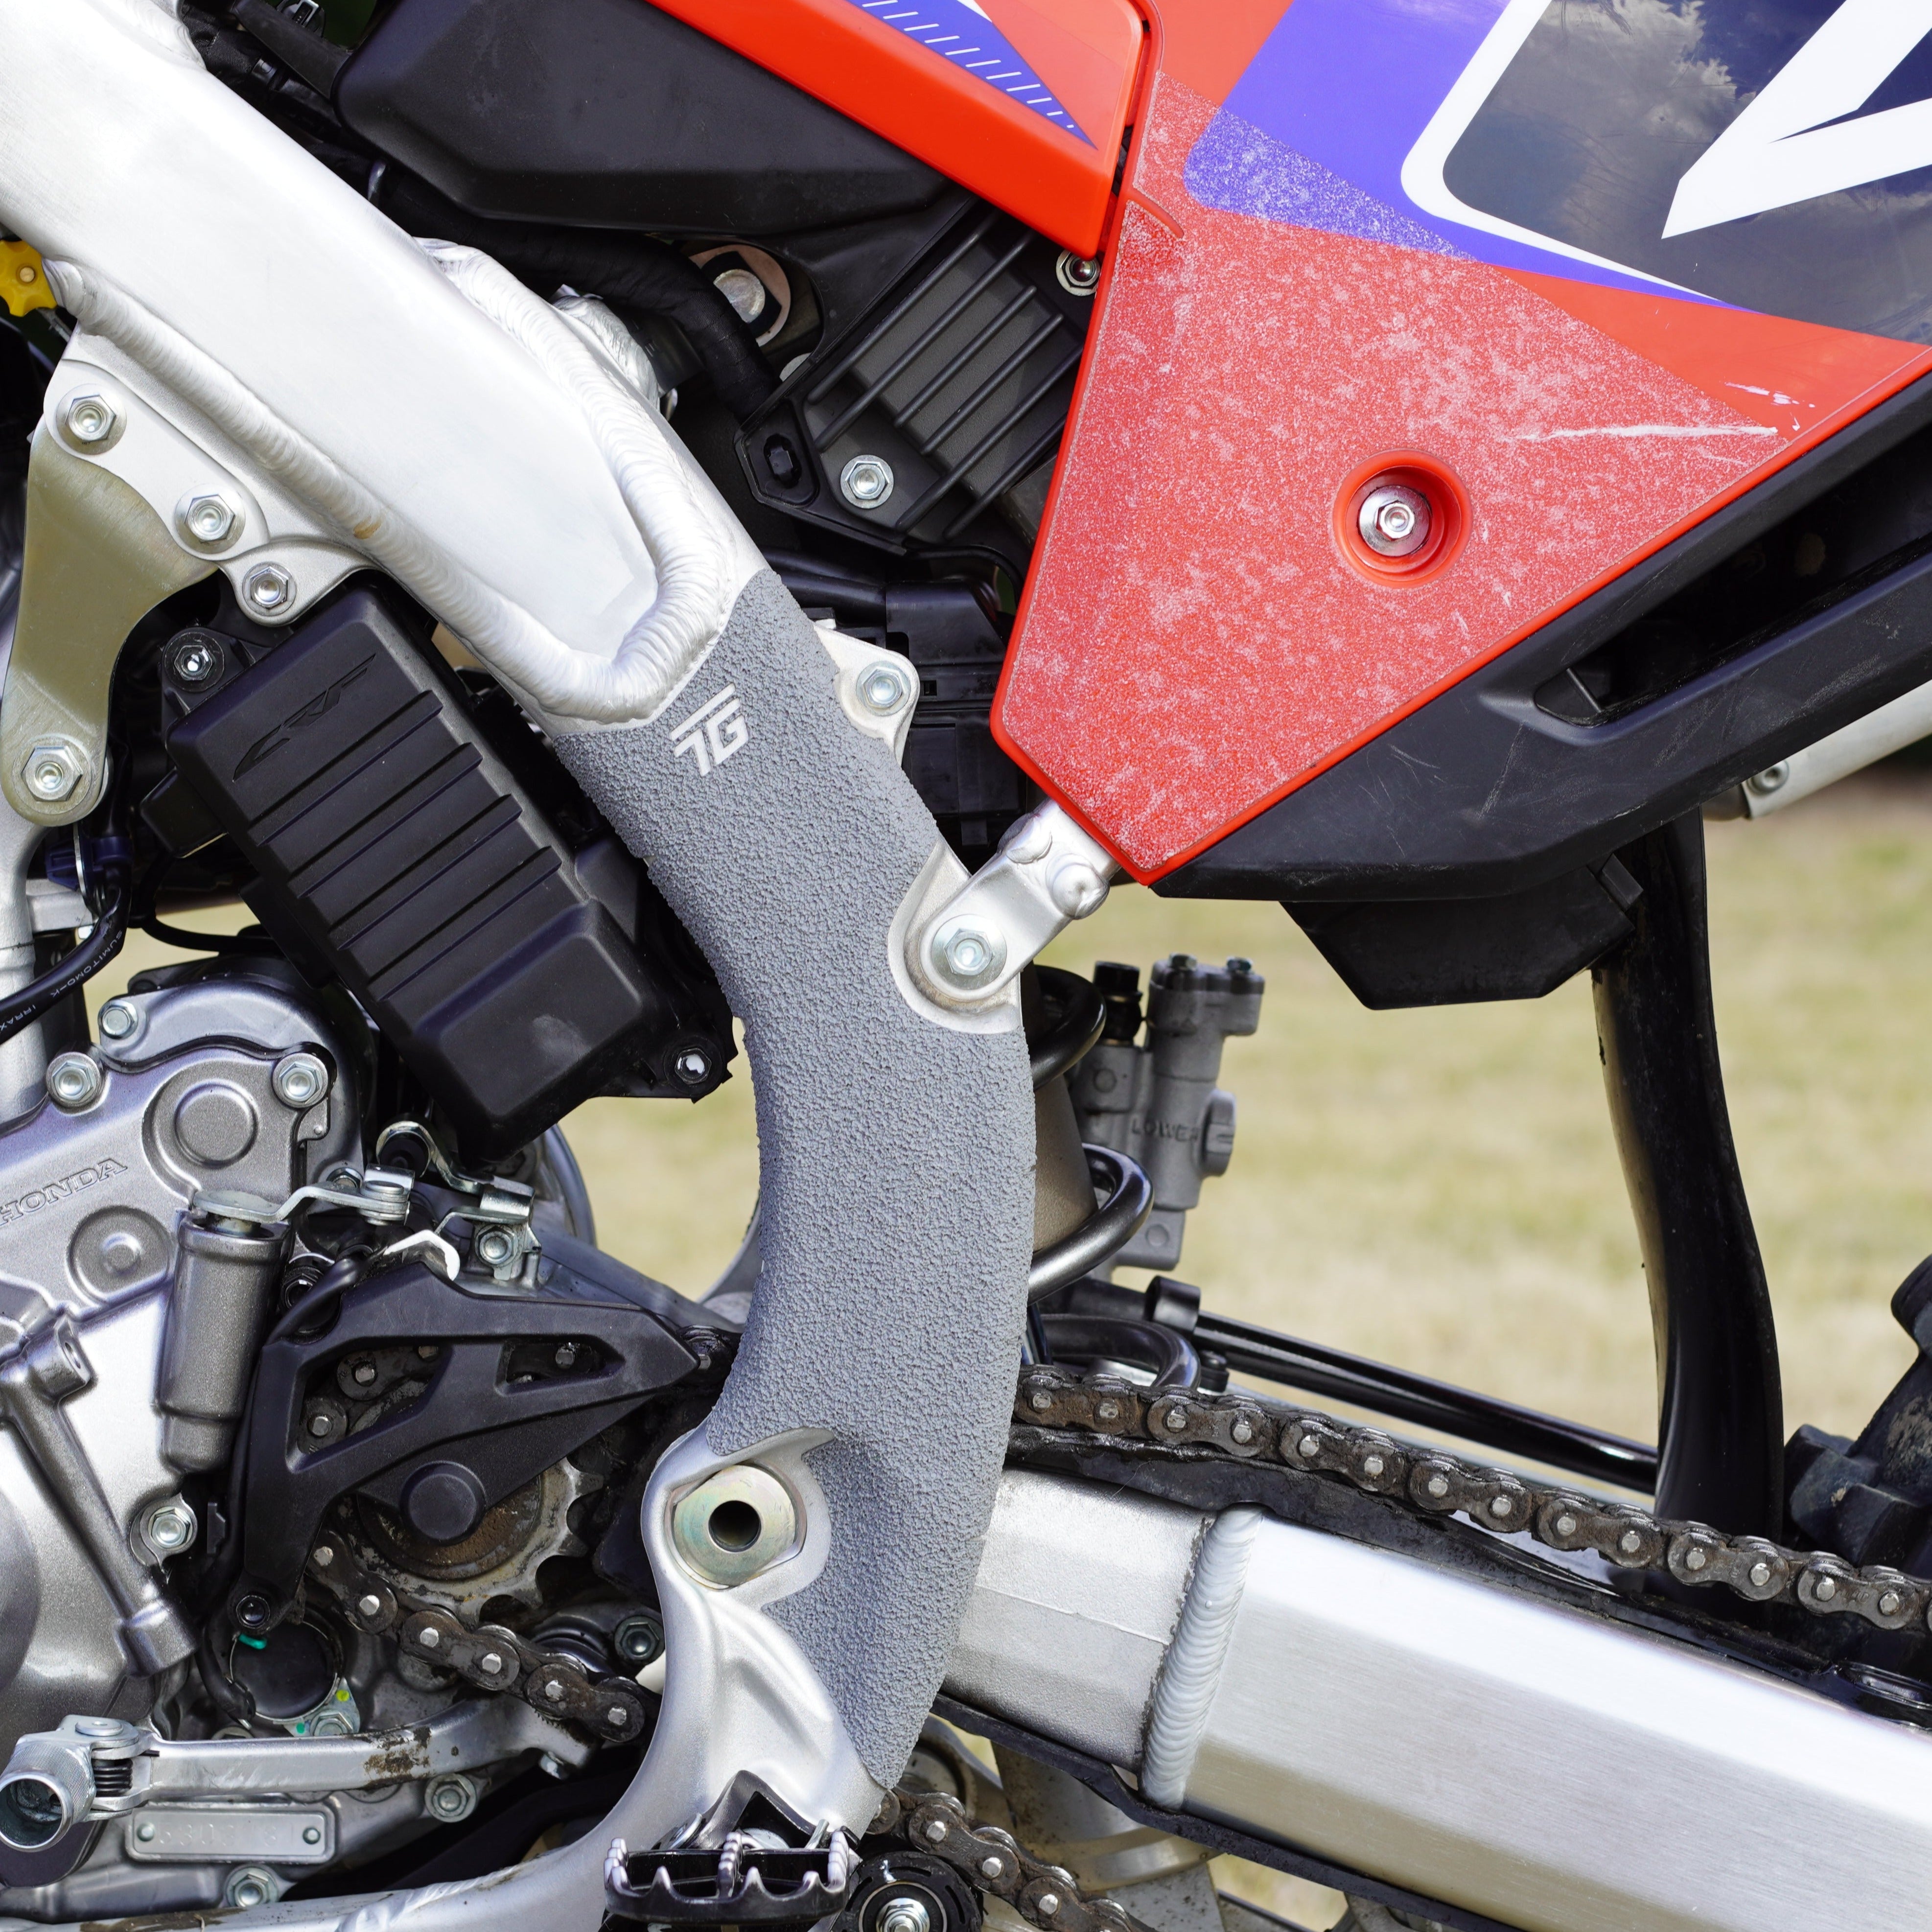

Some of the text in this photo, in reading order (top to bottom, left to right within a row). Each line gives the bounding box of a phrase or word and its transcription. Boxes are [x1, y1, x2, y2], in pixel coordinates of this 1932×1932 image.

[233, 653, 376, 782] CRF
[50, 931, 122, 998] SUMITOMO-K
[0, 1158, 127, 1225] HONDA
